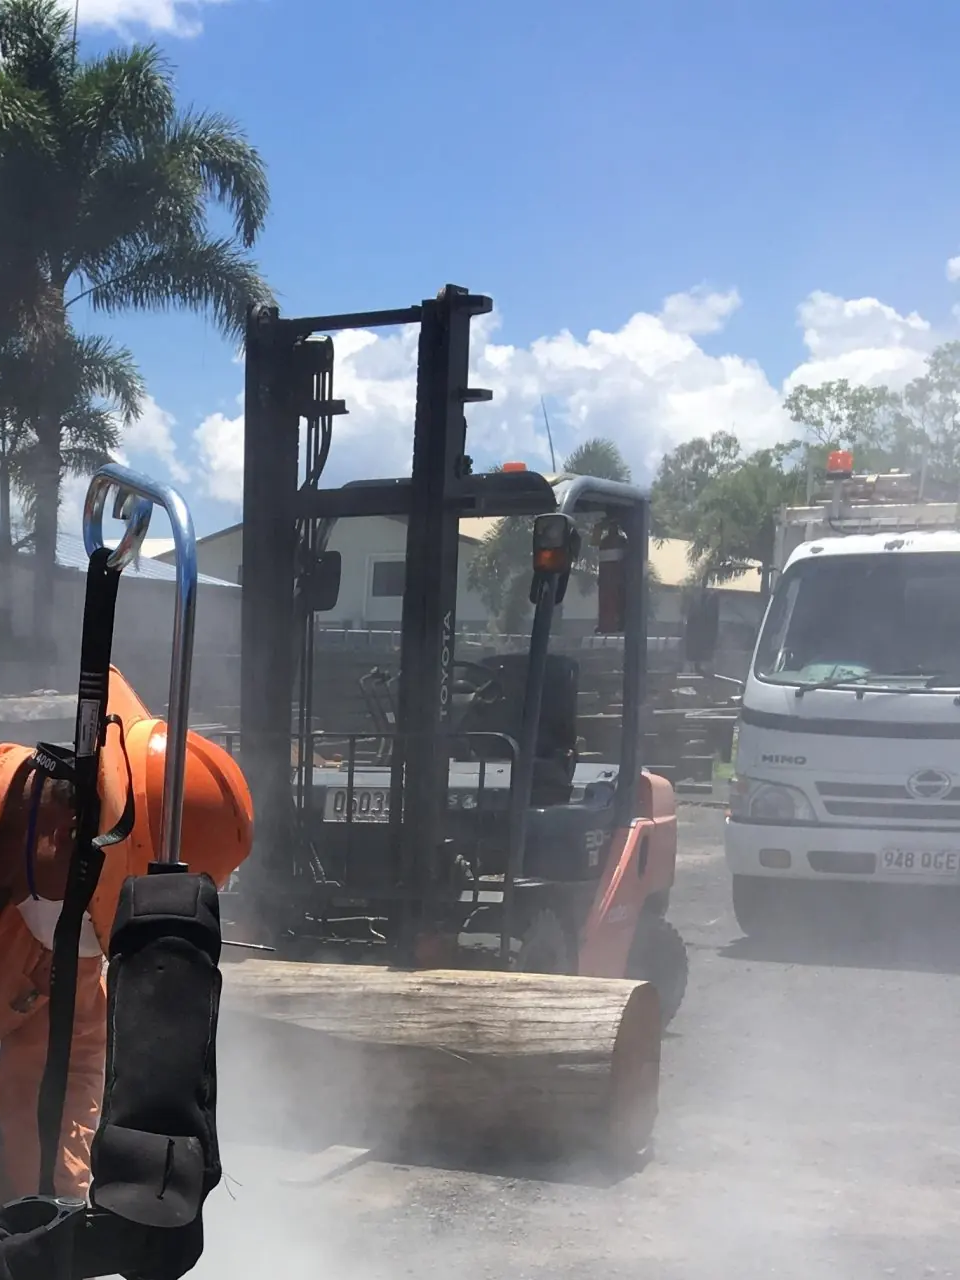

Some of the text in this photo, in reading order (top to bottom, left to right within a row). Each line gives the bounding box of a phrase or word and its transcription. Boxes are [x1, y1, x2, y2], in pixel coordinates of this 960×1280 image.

[440, 610, 451, 721] TOYOTA
[36, 752, 56, 771] 4000
[884, 851, 915, 868] 948
